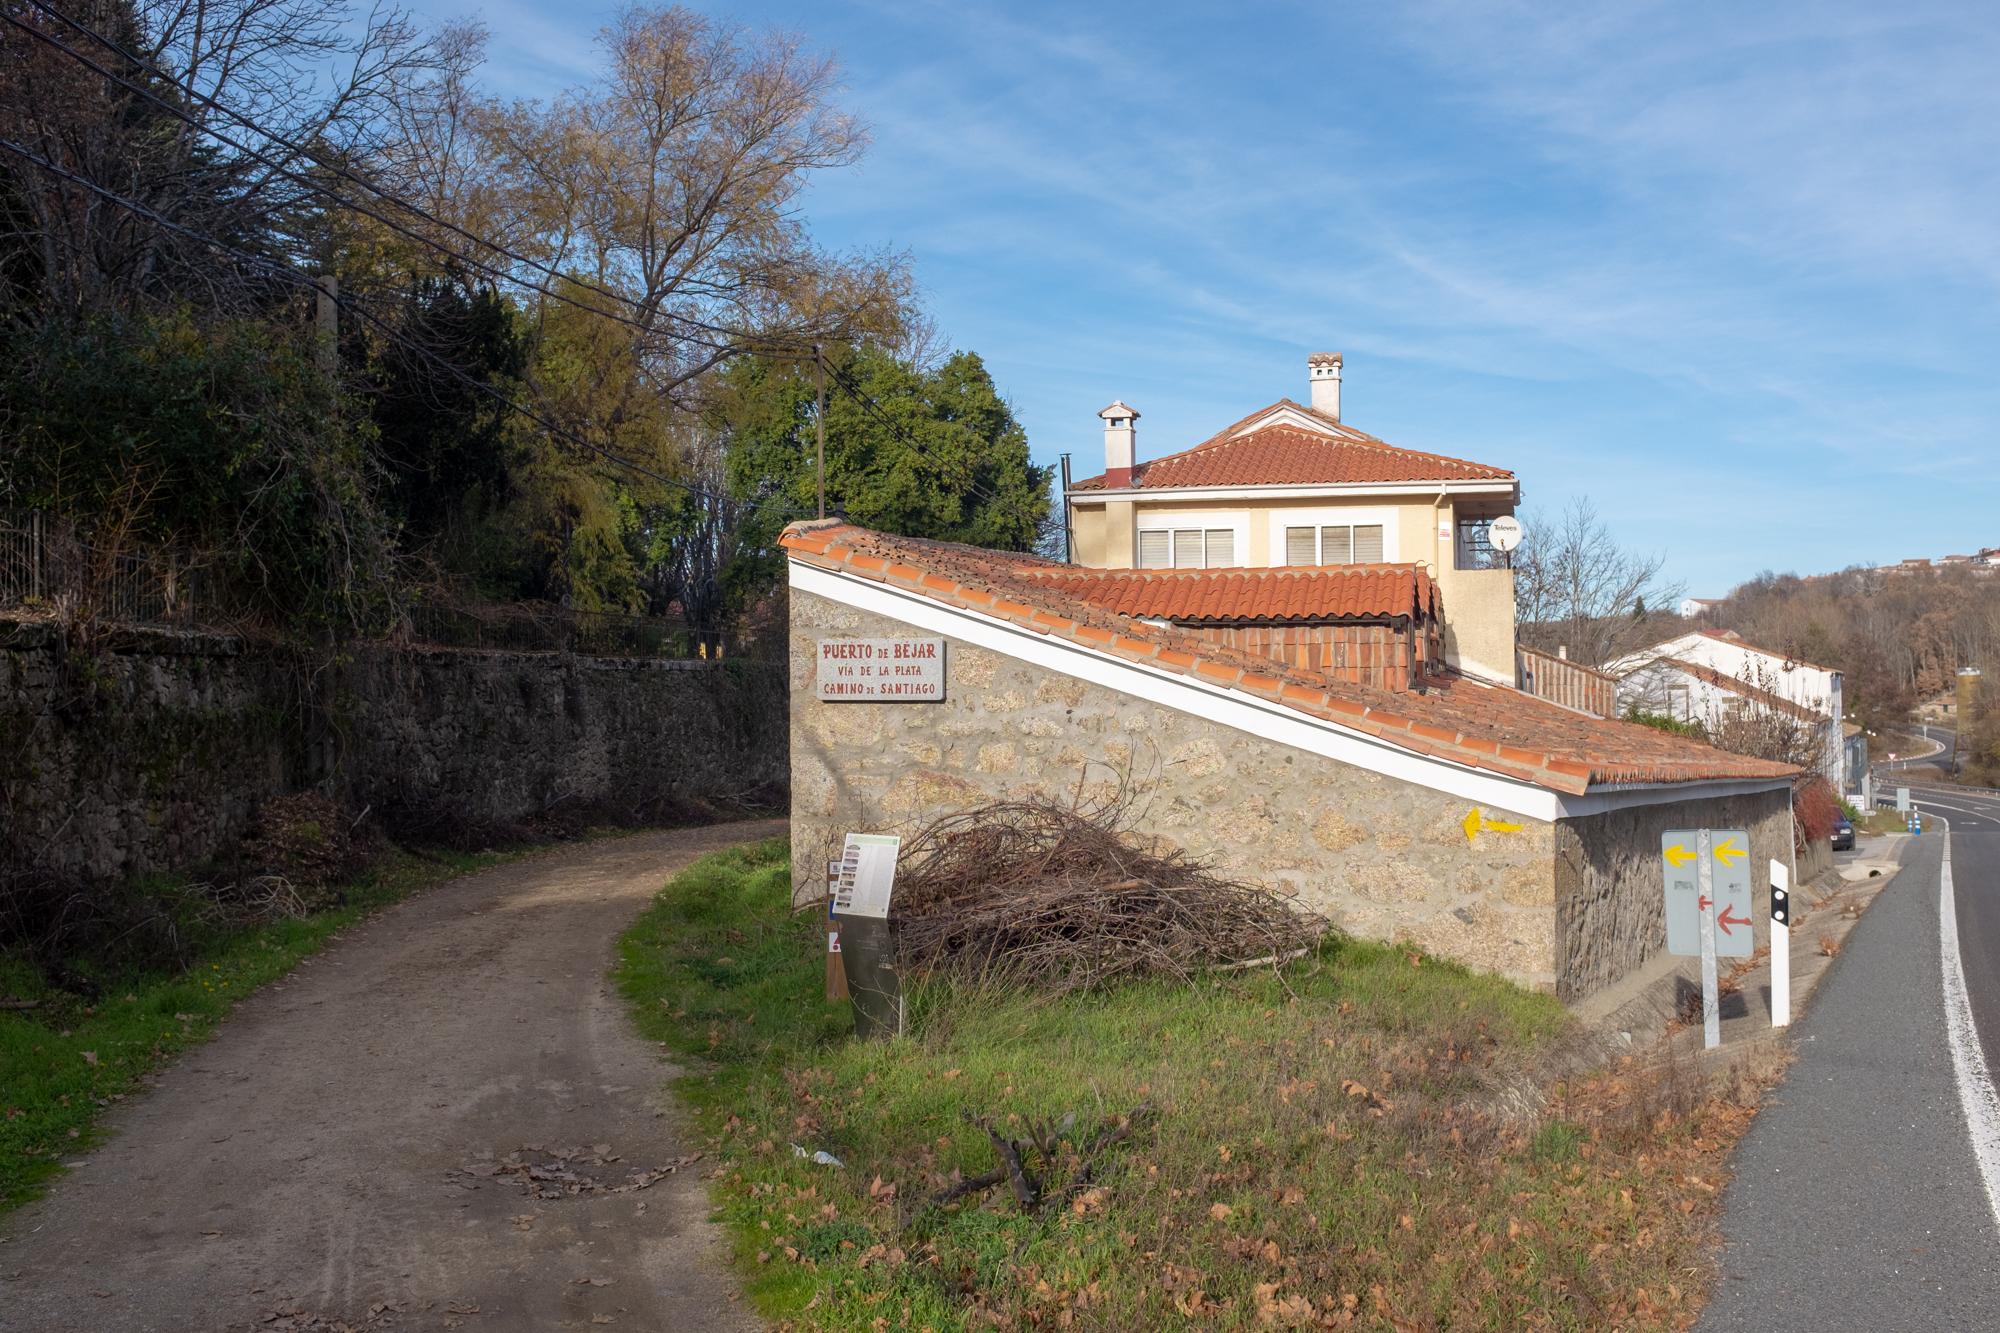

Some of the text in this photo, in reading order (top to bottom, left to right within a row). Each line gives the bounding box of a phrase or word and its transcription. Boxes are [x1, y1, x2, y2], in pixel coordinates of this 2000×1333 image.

[823, 644, 872, 658] PUERTO
[878, 648, 888, 658] DE
[860, 666, 871, 676] DE
[879, 666, 889, 676] LA
[895, 666, 922, 676] PLATA
[823, 683, 864, 694] CAMINO
[880, 683, 935, 694] SANTIAGO
